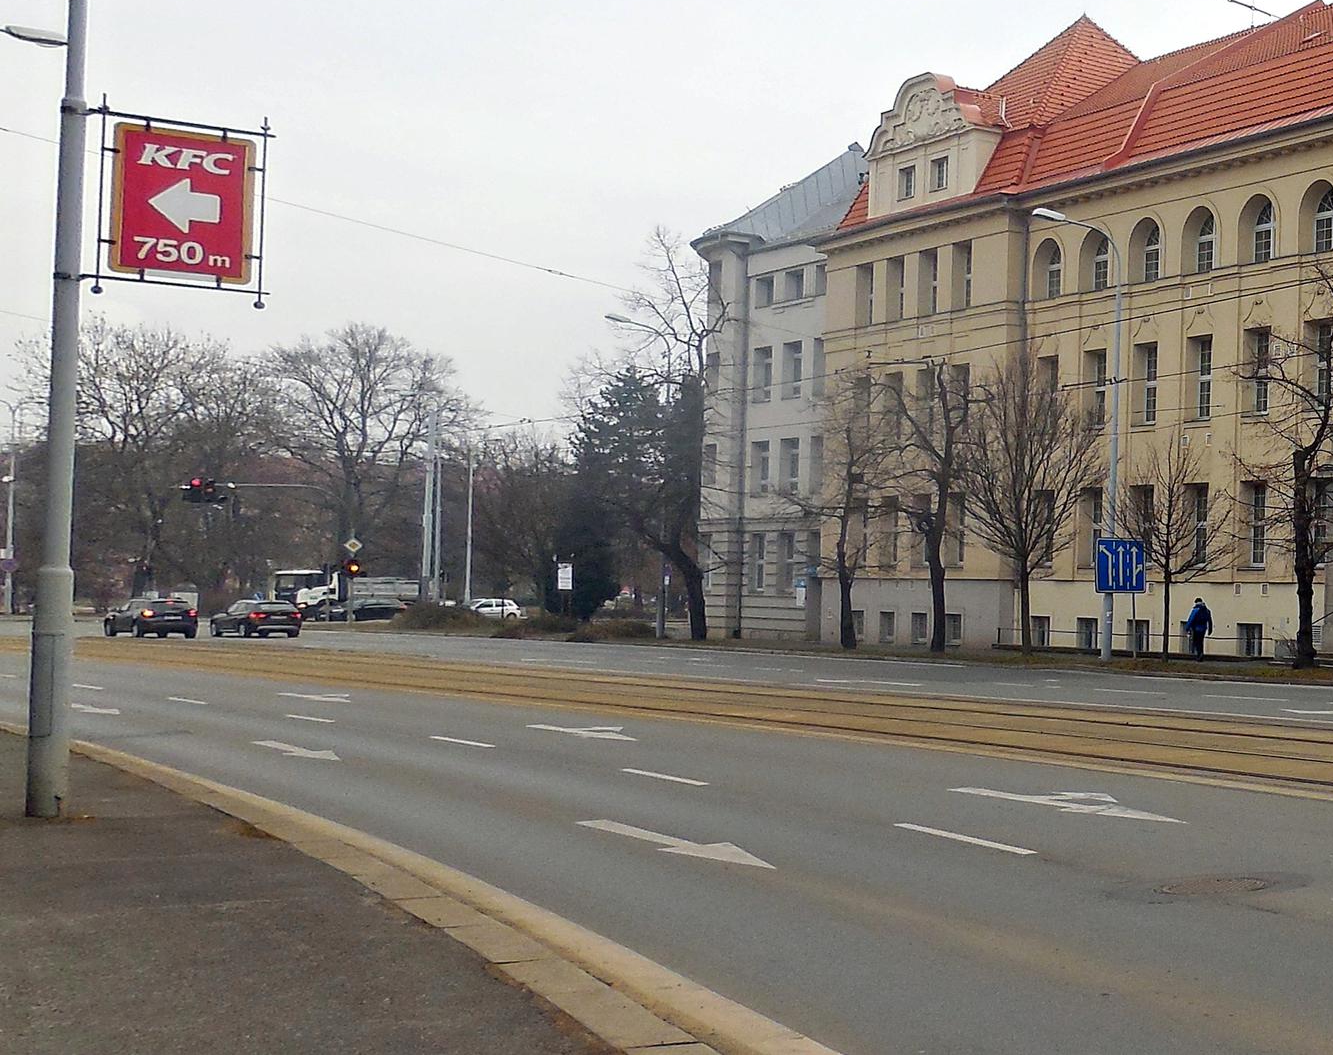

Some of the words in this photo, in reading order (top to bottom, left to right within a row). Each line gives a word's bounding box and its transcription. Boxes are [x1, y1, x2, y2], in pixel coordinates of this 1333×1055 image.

[137, 143, 234, 175] KFC
[133, 236, 204, 265] 750
[208, 254, 231, 268] m
